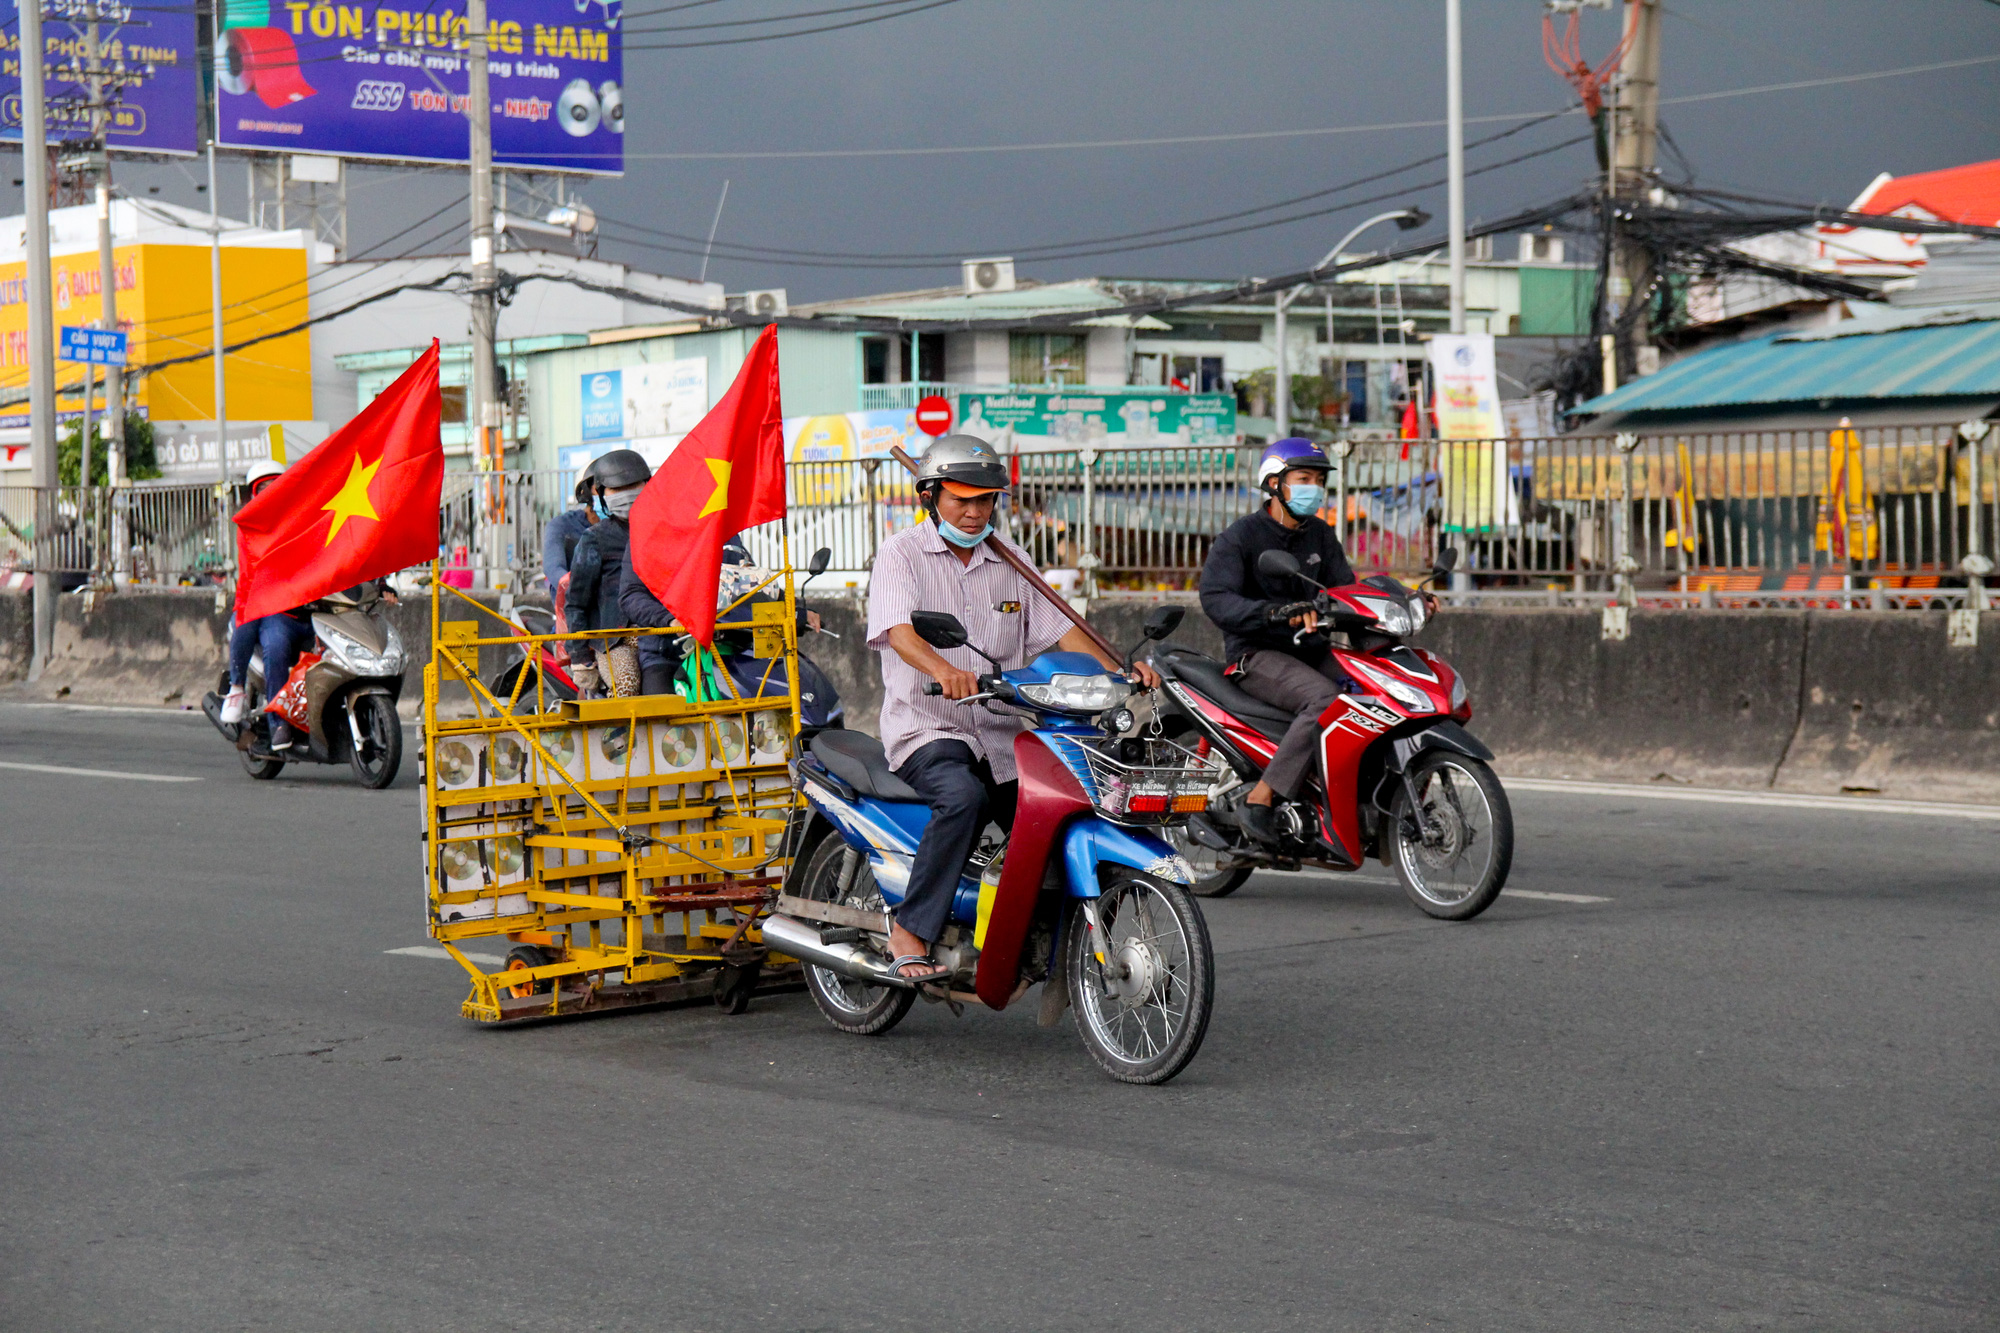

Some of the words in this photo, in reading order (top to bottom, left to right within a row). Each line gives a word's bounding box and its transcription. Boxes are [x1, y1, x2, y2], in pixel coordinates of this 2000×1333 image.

[285, 0, 363, 40] TÔN
[534, 23, 609, 62] NAM
[425, 55, 461, 74] mọi
[464, 59, 512, 78] cng
[410, 88, 447, 112] TÔN
[505, 96, 552, 122] NHẬT
[1343, 710, 1381, 730] RSX
[1370, 706, 1399, 721] 110
